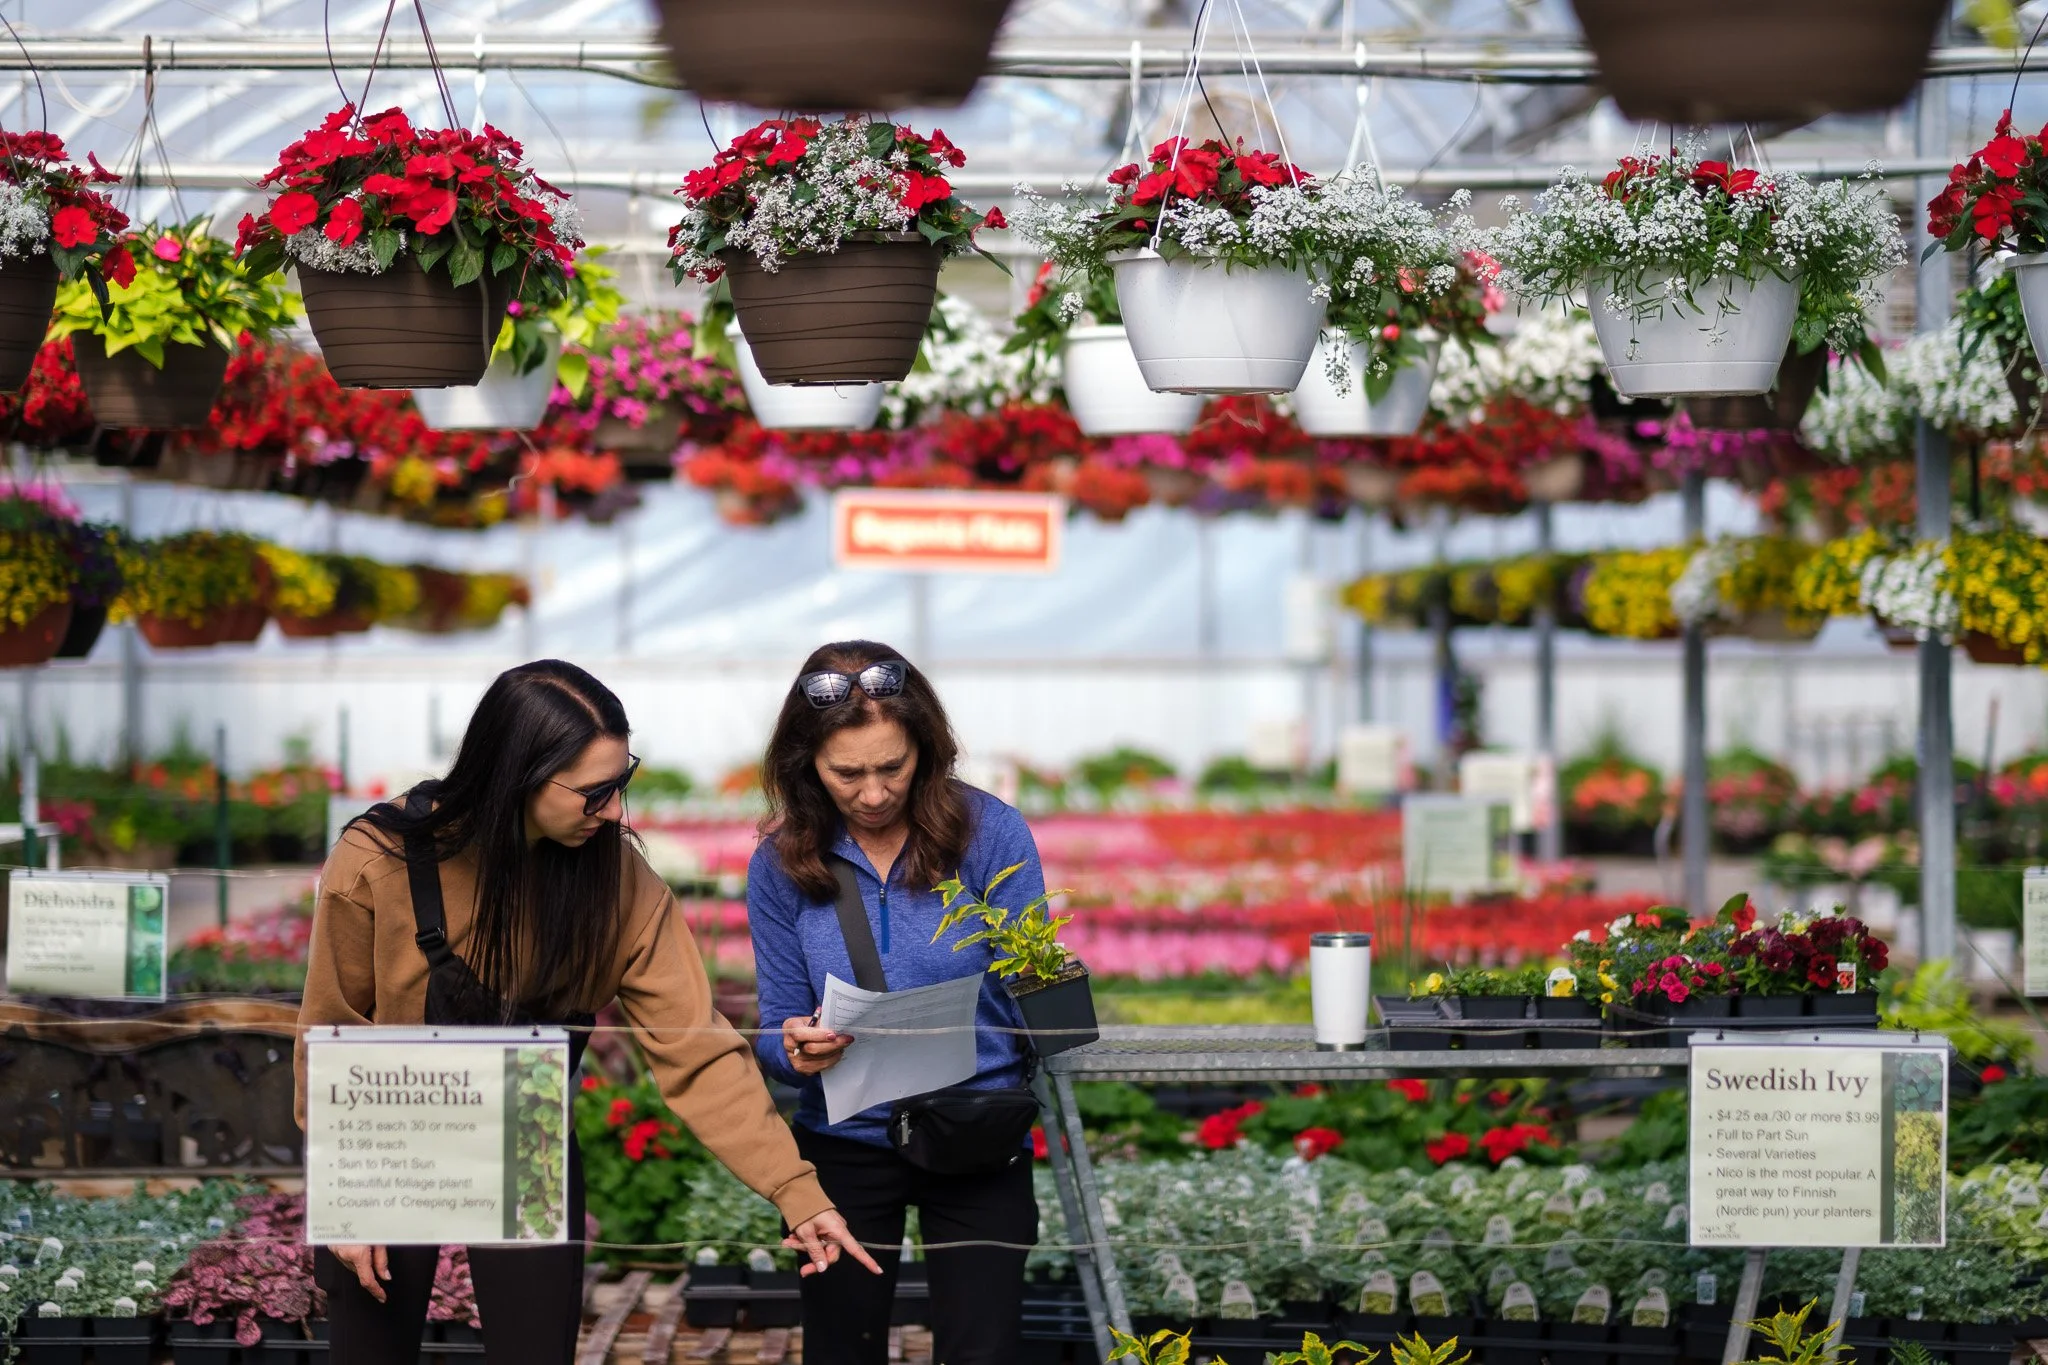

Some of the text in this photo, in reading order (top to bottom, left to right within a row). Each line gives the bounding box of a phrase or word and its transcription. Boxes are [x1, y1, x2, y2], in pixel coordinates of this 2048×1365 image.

[349, 1064, 471, 1087] Sunburst
[1706, 1067, 1868, 1098] Swedish Ivy
[329, 1083, 483, 1111] Lysimachia
[1717, 1109, 1750, 1122] $4.25
[1795, 1114, 1807, 1122] or
[1811, 1114, 1842, 1123] more
[1846, 1111, 1880, 1124] $3.99
[376, 1121, 406, 1132] each
[411, 1119, 426, 1132] 30
[429, 1122, 441, 1132] or
[445, 1121, 476, 1132] more
[1716, 1129, 1809, 1141] Full to Part Sun
[376, 1139, 407, 1150] each
[1716, 1148, 1816, 1160] Several Varieties
[338, 1157, 435, 1170] Sun to Part Sun
[1716, 1167, 1743, 1179] Nico
[1747, 1168, 1756, 1179] is
[1760, 1168, 1778, 1179] the
[1782, 1169, 1812, 1180] most
[1867, 1169, 1876, 1180] A
[337, 1176, 391, 1189] Beautiful
[394, 1176, 436, 1191] foliage
[1716, 1187, 1837, 1201] great way to Finnish
[337, 1195, 497, 1211] Cousin of Creeping Jenny
[1716, 1205, 1759, 1219] (Nordic
[1763, 1206, 1789, 1219] pun)
[1793, 1208, 1819, 1219] your
